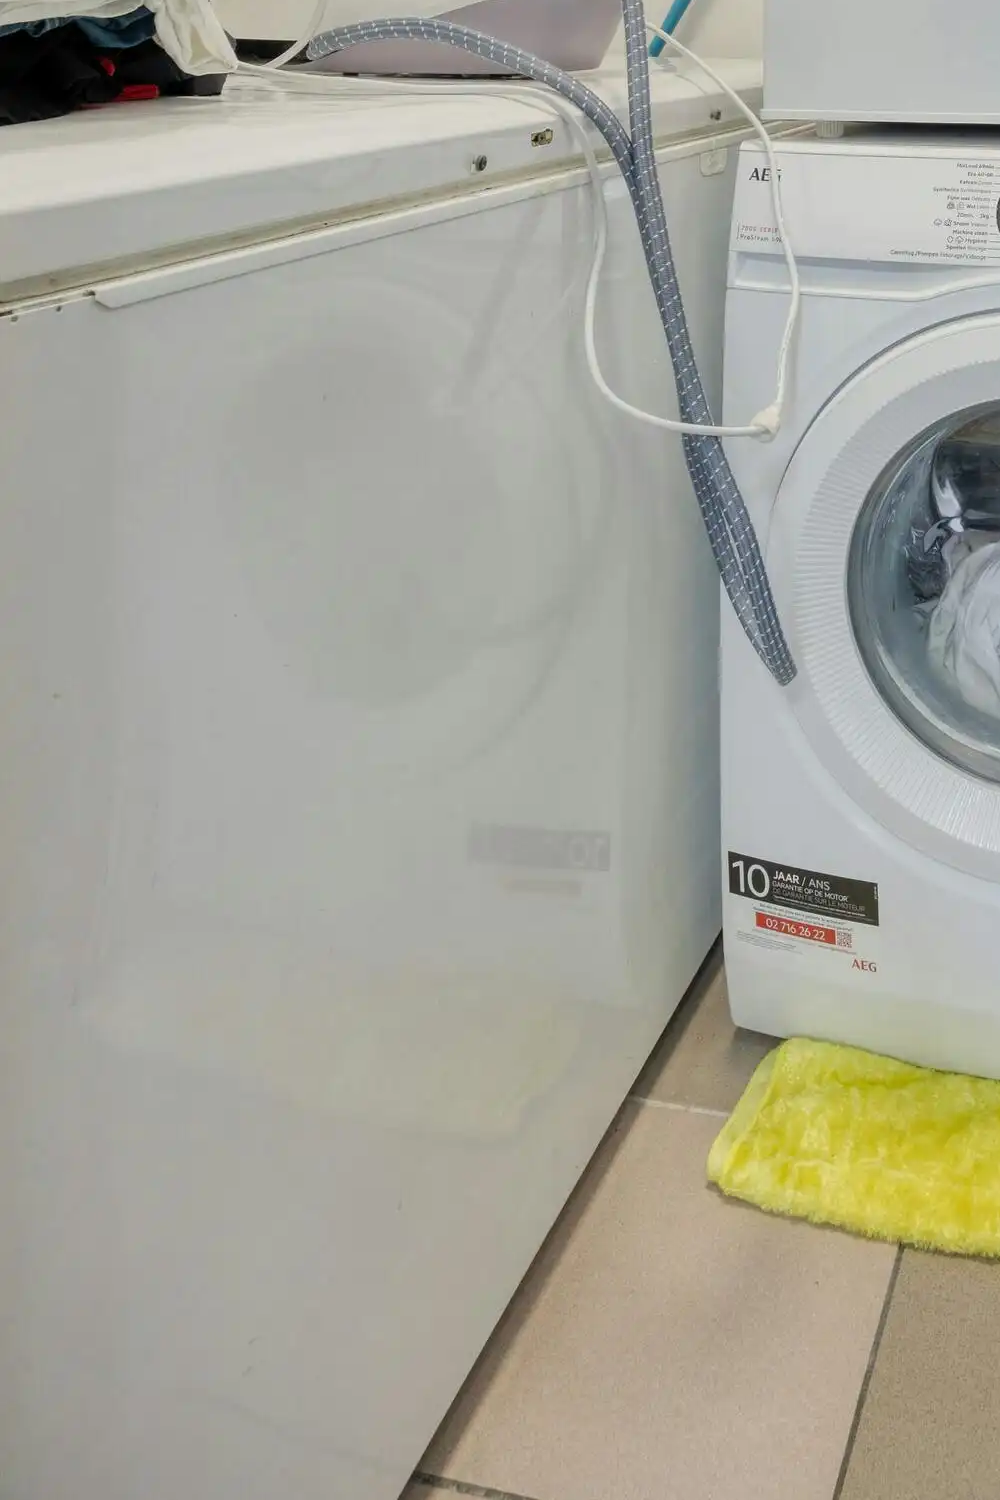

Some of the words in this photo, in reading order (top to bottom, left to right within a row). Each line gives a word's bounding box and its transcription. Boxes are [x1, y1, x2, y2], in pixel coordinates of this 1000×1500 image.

[731, 859, 771, 899] 10
[772, 870, 801, 885] JAAR
[808, 878, 831, 891] ANS
[772, 881, 803, 893] GARANTIE
[803, 887, 814, 895] OP
[814, 890, 824, 898] DE
[815, 896, 829, 905] SUR
[829, 898, 837, 907] LE
[765, 918, 779, 930] 02
[780, 922, 797, 934] 716
[799, 926, 811, 938] 26
[813, 929, 826, 941] 22
[851, 958, 877, 973] AEG
